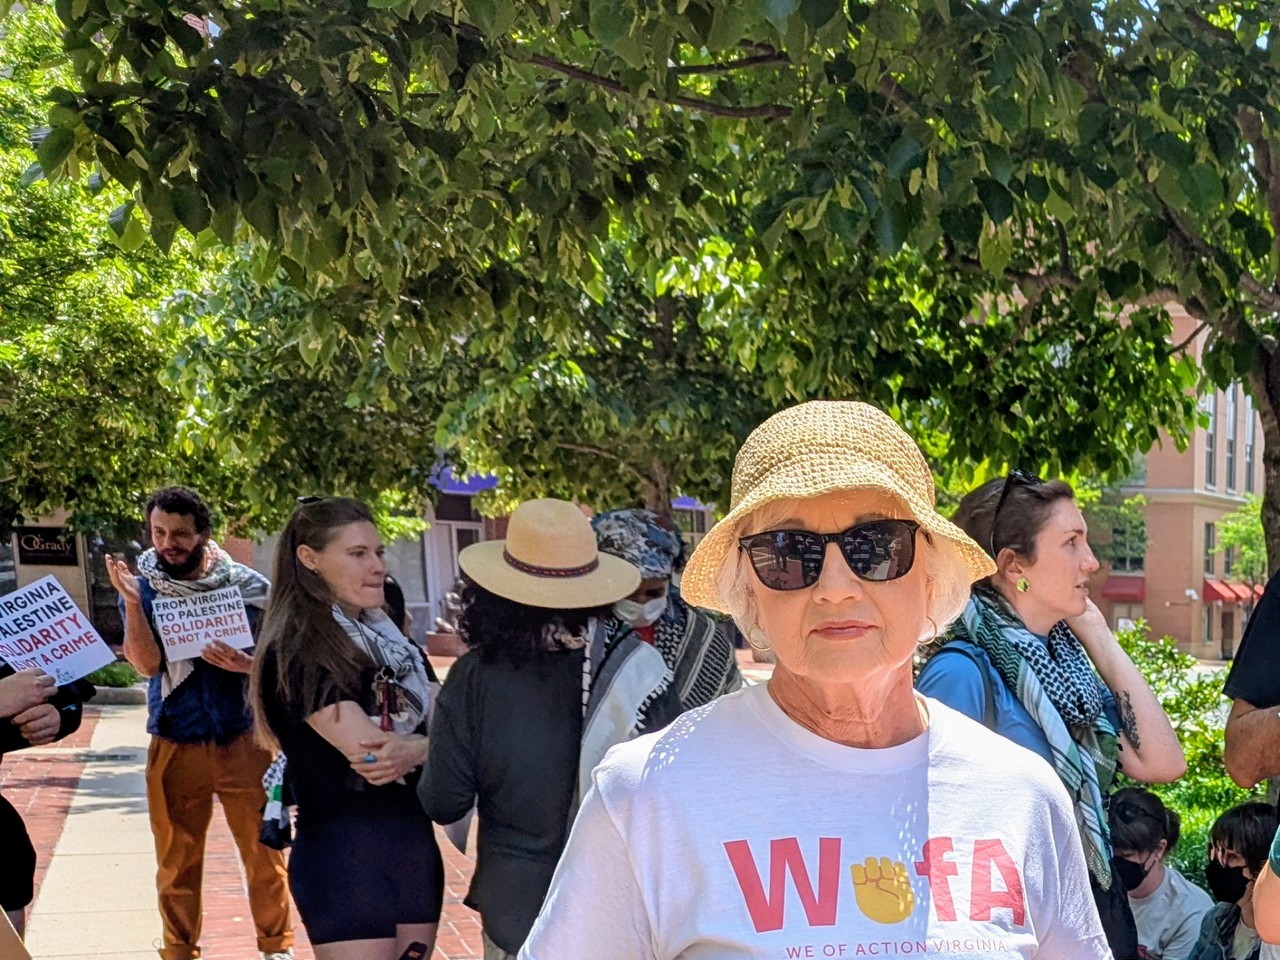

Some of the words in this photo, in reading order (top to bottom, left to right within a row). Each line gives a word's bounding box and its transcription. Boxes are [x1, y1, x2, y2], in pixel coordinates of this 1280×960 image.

[0, 582, 61, 618] IRGINIA
[155, 599, 188, 612] FROM
[190, 589, 240, 606] VIRGINIA
[158, 613, 175, 623] TO
[178, 600, 243, 619] PALESTINE
[0, 596, 74, 640] ALESTINE
[162, 612, 244, 636] SOLIDARITY
[165, 637, 176, 646] IS
[178, 632, 200, 644] NOT
[204, 631, 212, 639] A
[214, 624, 248, 638] CRIME
[40, 653, 53, 665] A
[51, 631, 97, 659] CRIME
[786, 946, 814, 960] WE
[823, 944, 847, 957] OF
[855, 941, 927, 956] ACTION
[934, 938, 1006, 954] VIRGINIA
